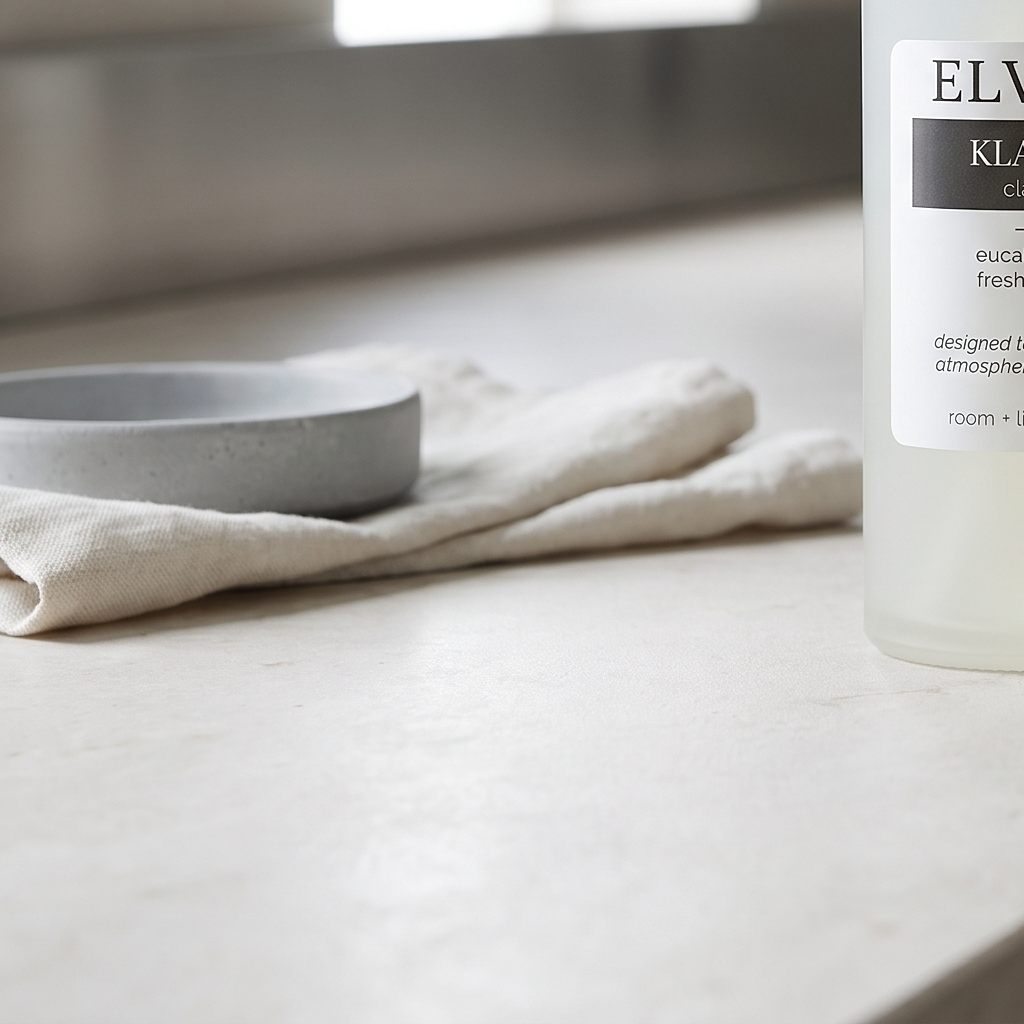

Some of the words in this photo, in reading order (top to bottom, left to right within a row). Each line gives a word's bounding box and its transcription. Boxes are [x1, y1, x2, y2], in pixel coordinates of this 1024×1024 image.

[977, 271, 1024, 288] fresh
[934, 334, 1012, 355] designed
[949, 411, 995, 426] room
[1002, 414, 1010, 423] +
